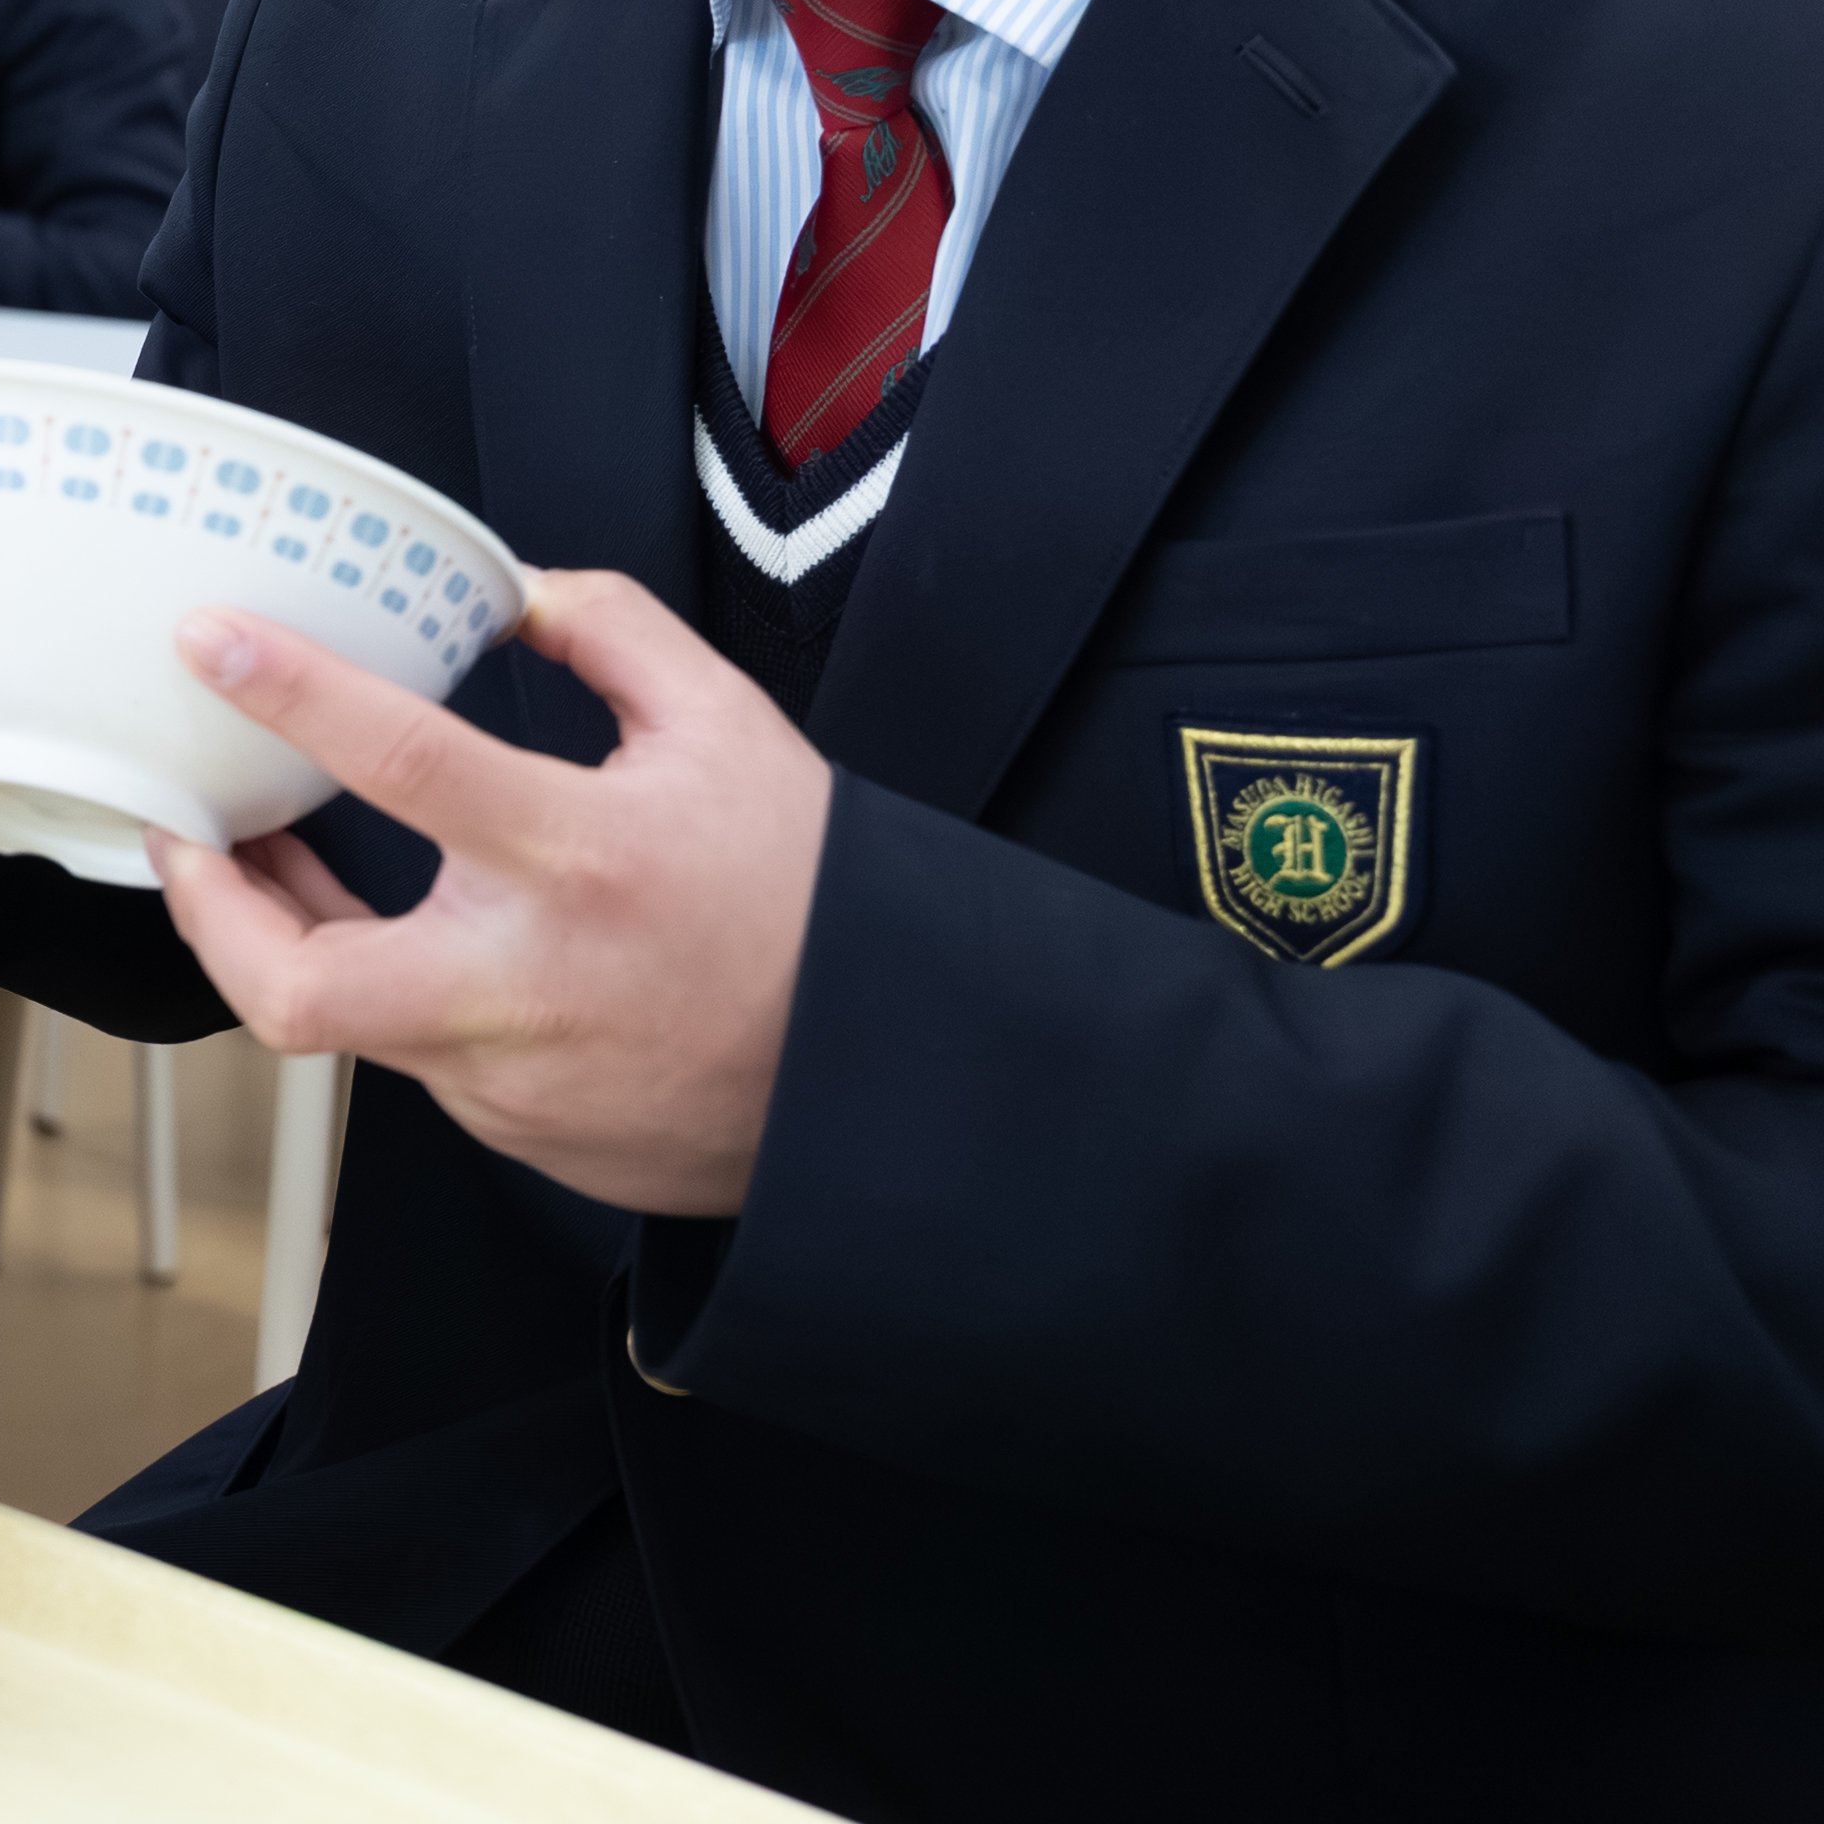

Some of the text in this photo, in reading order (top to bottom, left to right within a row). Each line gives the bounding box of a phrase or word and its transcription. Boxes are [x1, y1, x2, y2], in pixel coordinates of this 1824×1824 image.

[1221, 772, 1376, 859] MASUDA HIGASHI
[1228, 860, 1372, 924] HIGH SCHOOL
